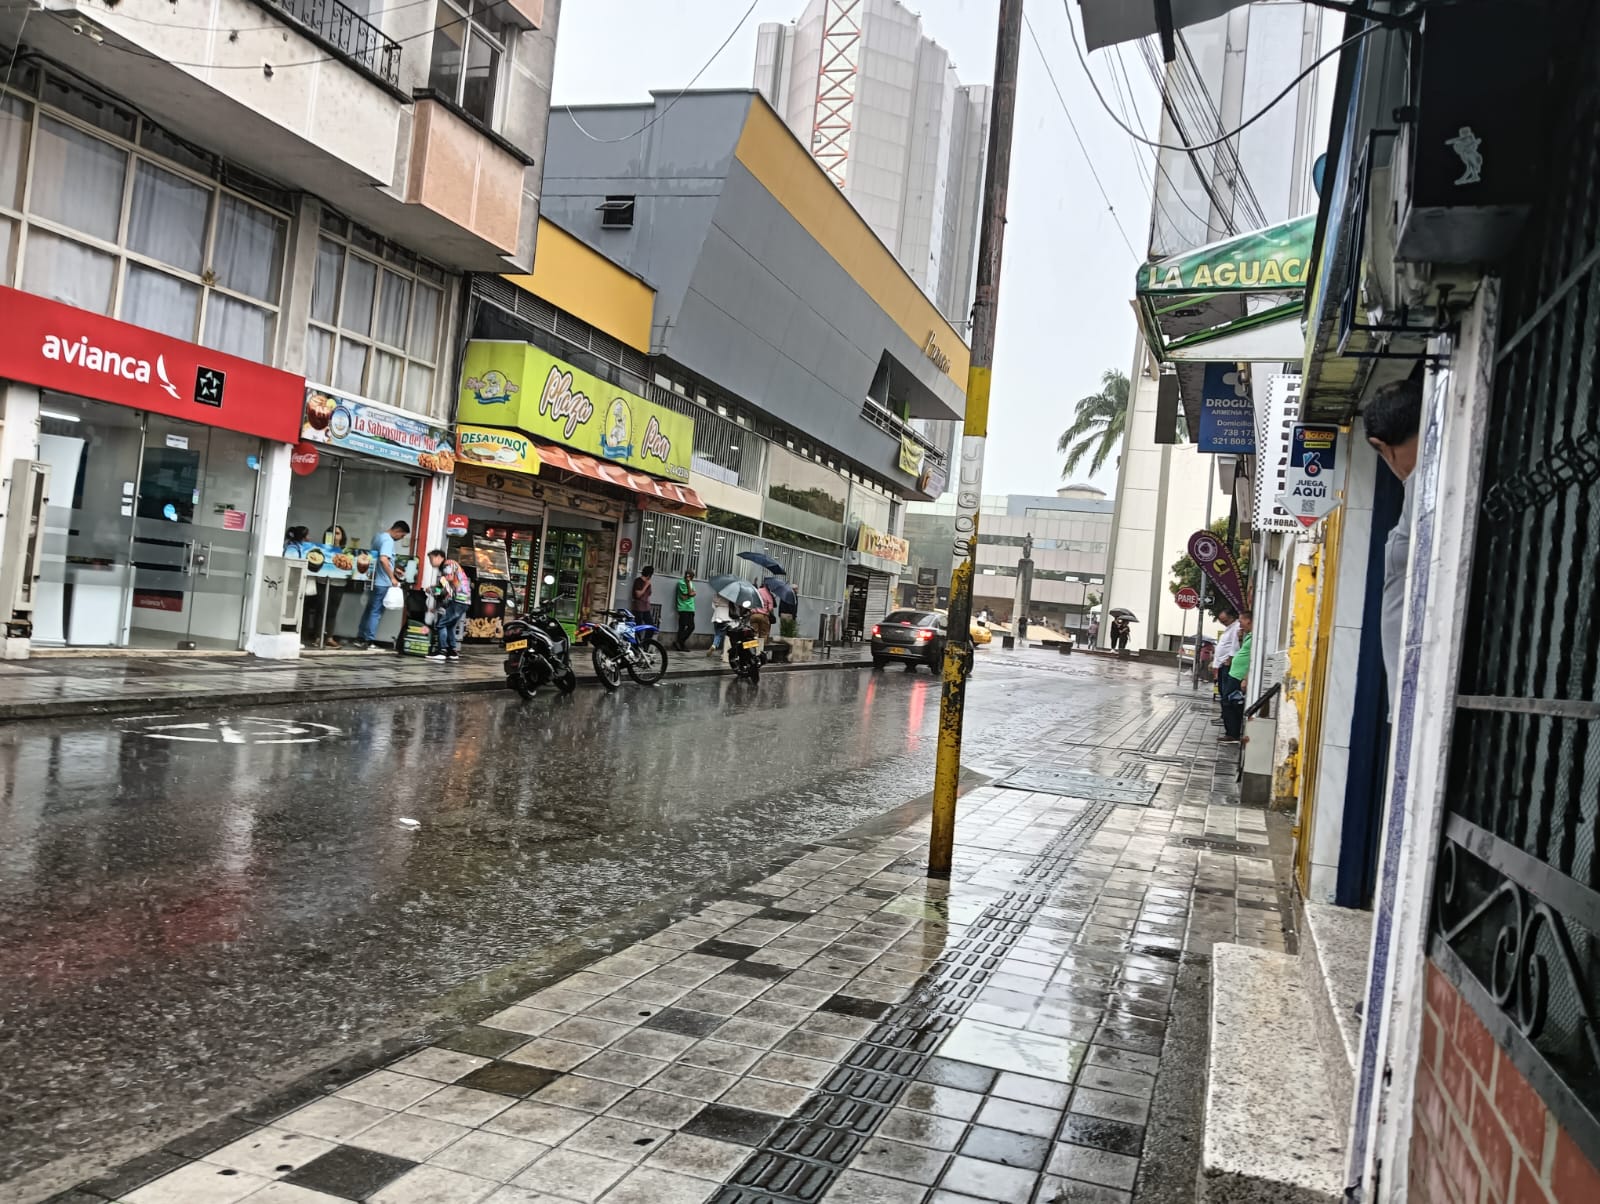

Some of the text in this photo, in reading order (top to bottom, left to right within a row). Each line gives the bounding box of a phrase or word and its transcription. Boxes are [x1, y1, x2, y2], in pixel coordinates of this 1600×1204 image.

[1148, 266, 1184, 289] LA
[41, 334, 151, 384] avianca
[540, 365, 671, 463] Plaza Pan
[354, 415, 365, 432] La
[367, 419, 407, 444] Sabrosura
[409, 432, 421, 447] del
[1212, 437, 1228, 445] 321
[461, 432, 528, 459] DESAYUNOS
[1292, 485, 1328, 498] AQUÍ
[1296, 479, 1324, 487] JUEGA
[952, 442, 981, 558] JUGOS
[1263, 517, 1298, 528] 24 HORAS
[1177, 594, 1197, 604] PARE
